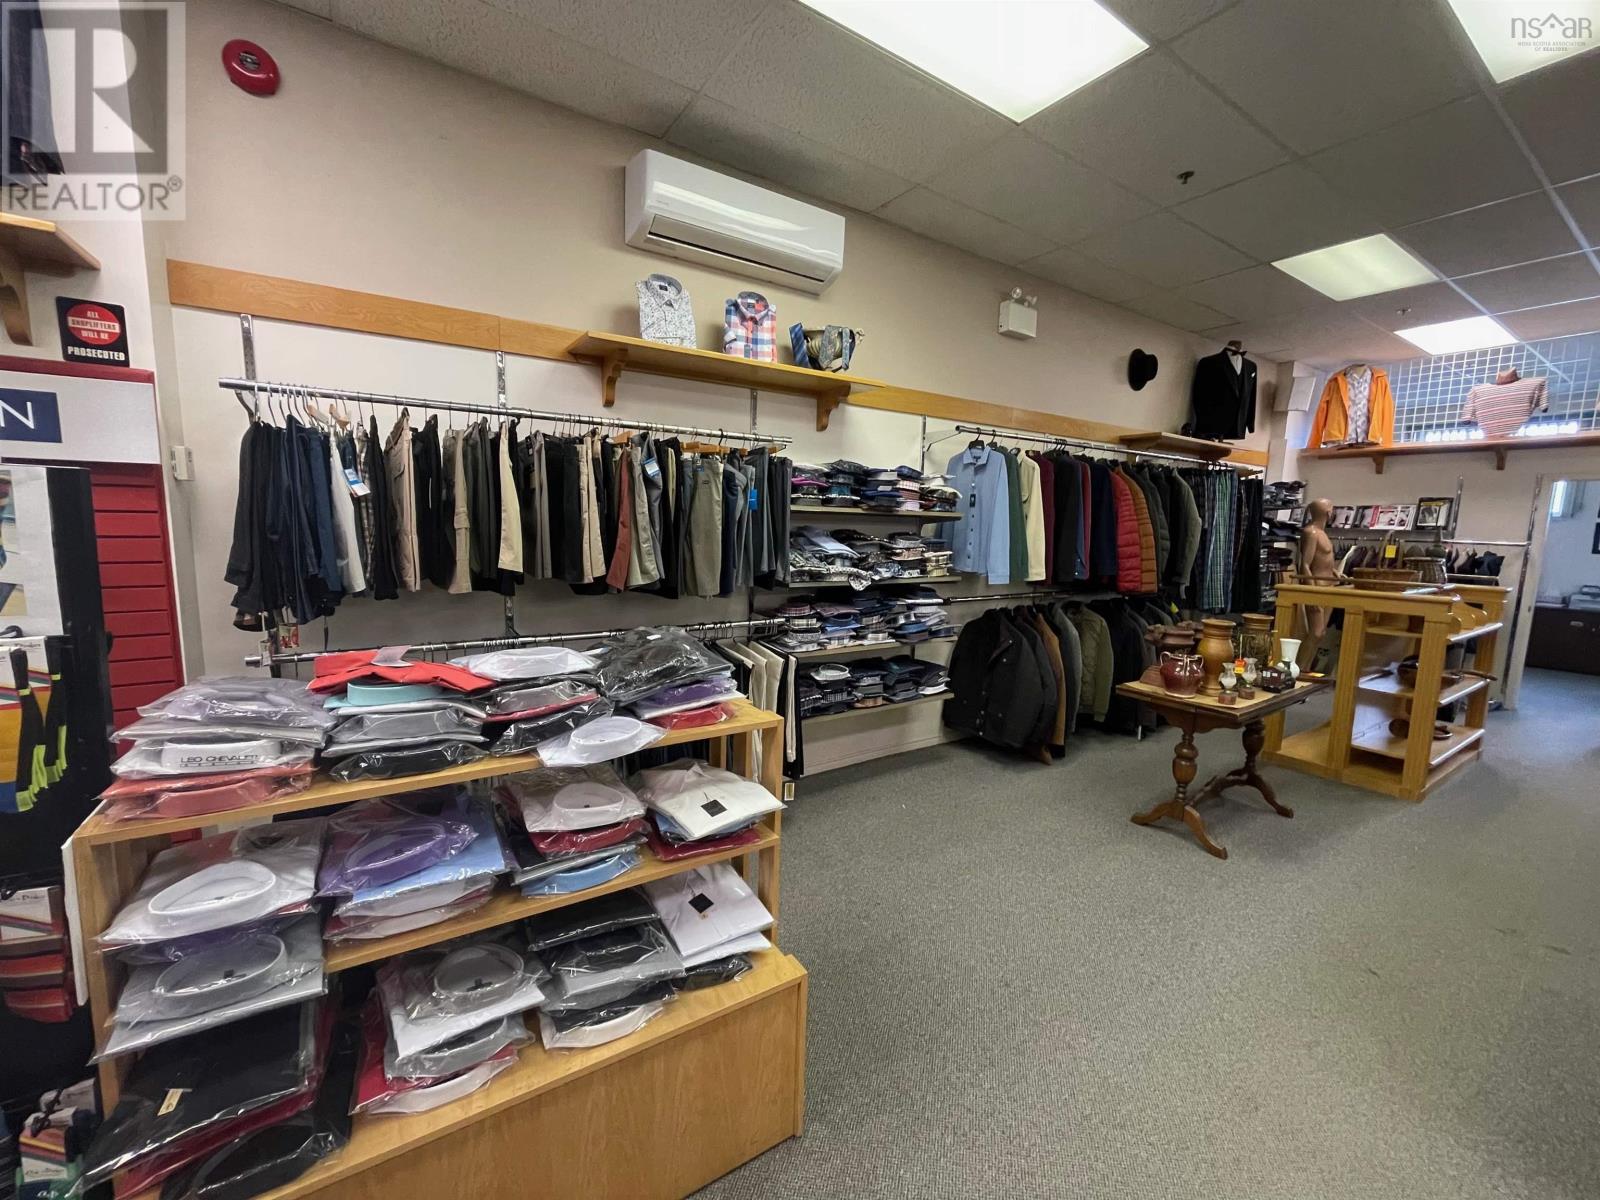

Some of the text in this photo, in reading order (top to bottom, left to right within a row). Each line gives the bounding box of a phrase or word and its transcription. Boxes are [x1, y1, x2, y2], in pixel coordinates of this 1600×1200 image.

[71, 319, 117, 330] SHOPLIFTERS
[81, 330, 98, 338] WILL
[67, 346, 125, 361] PROSECUTED
